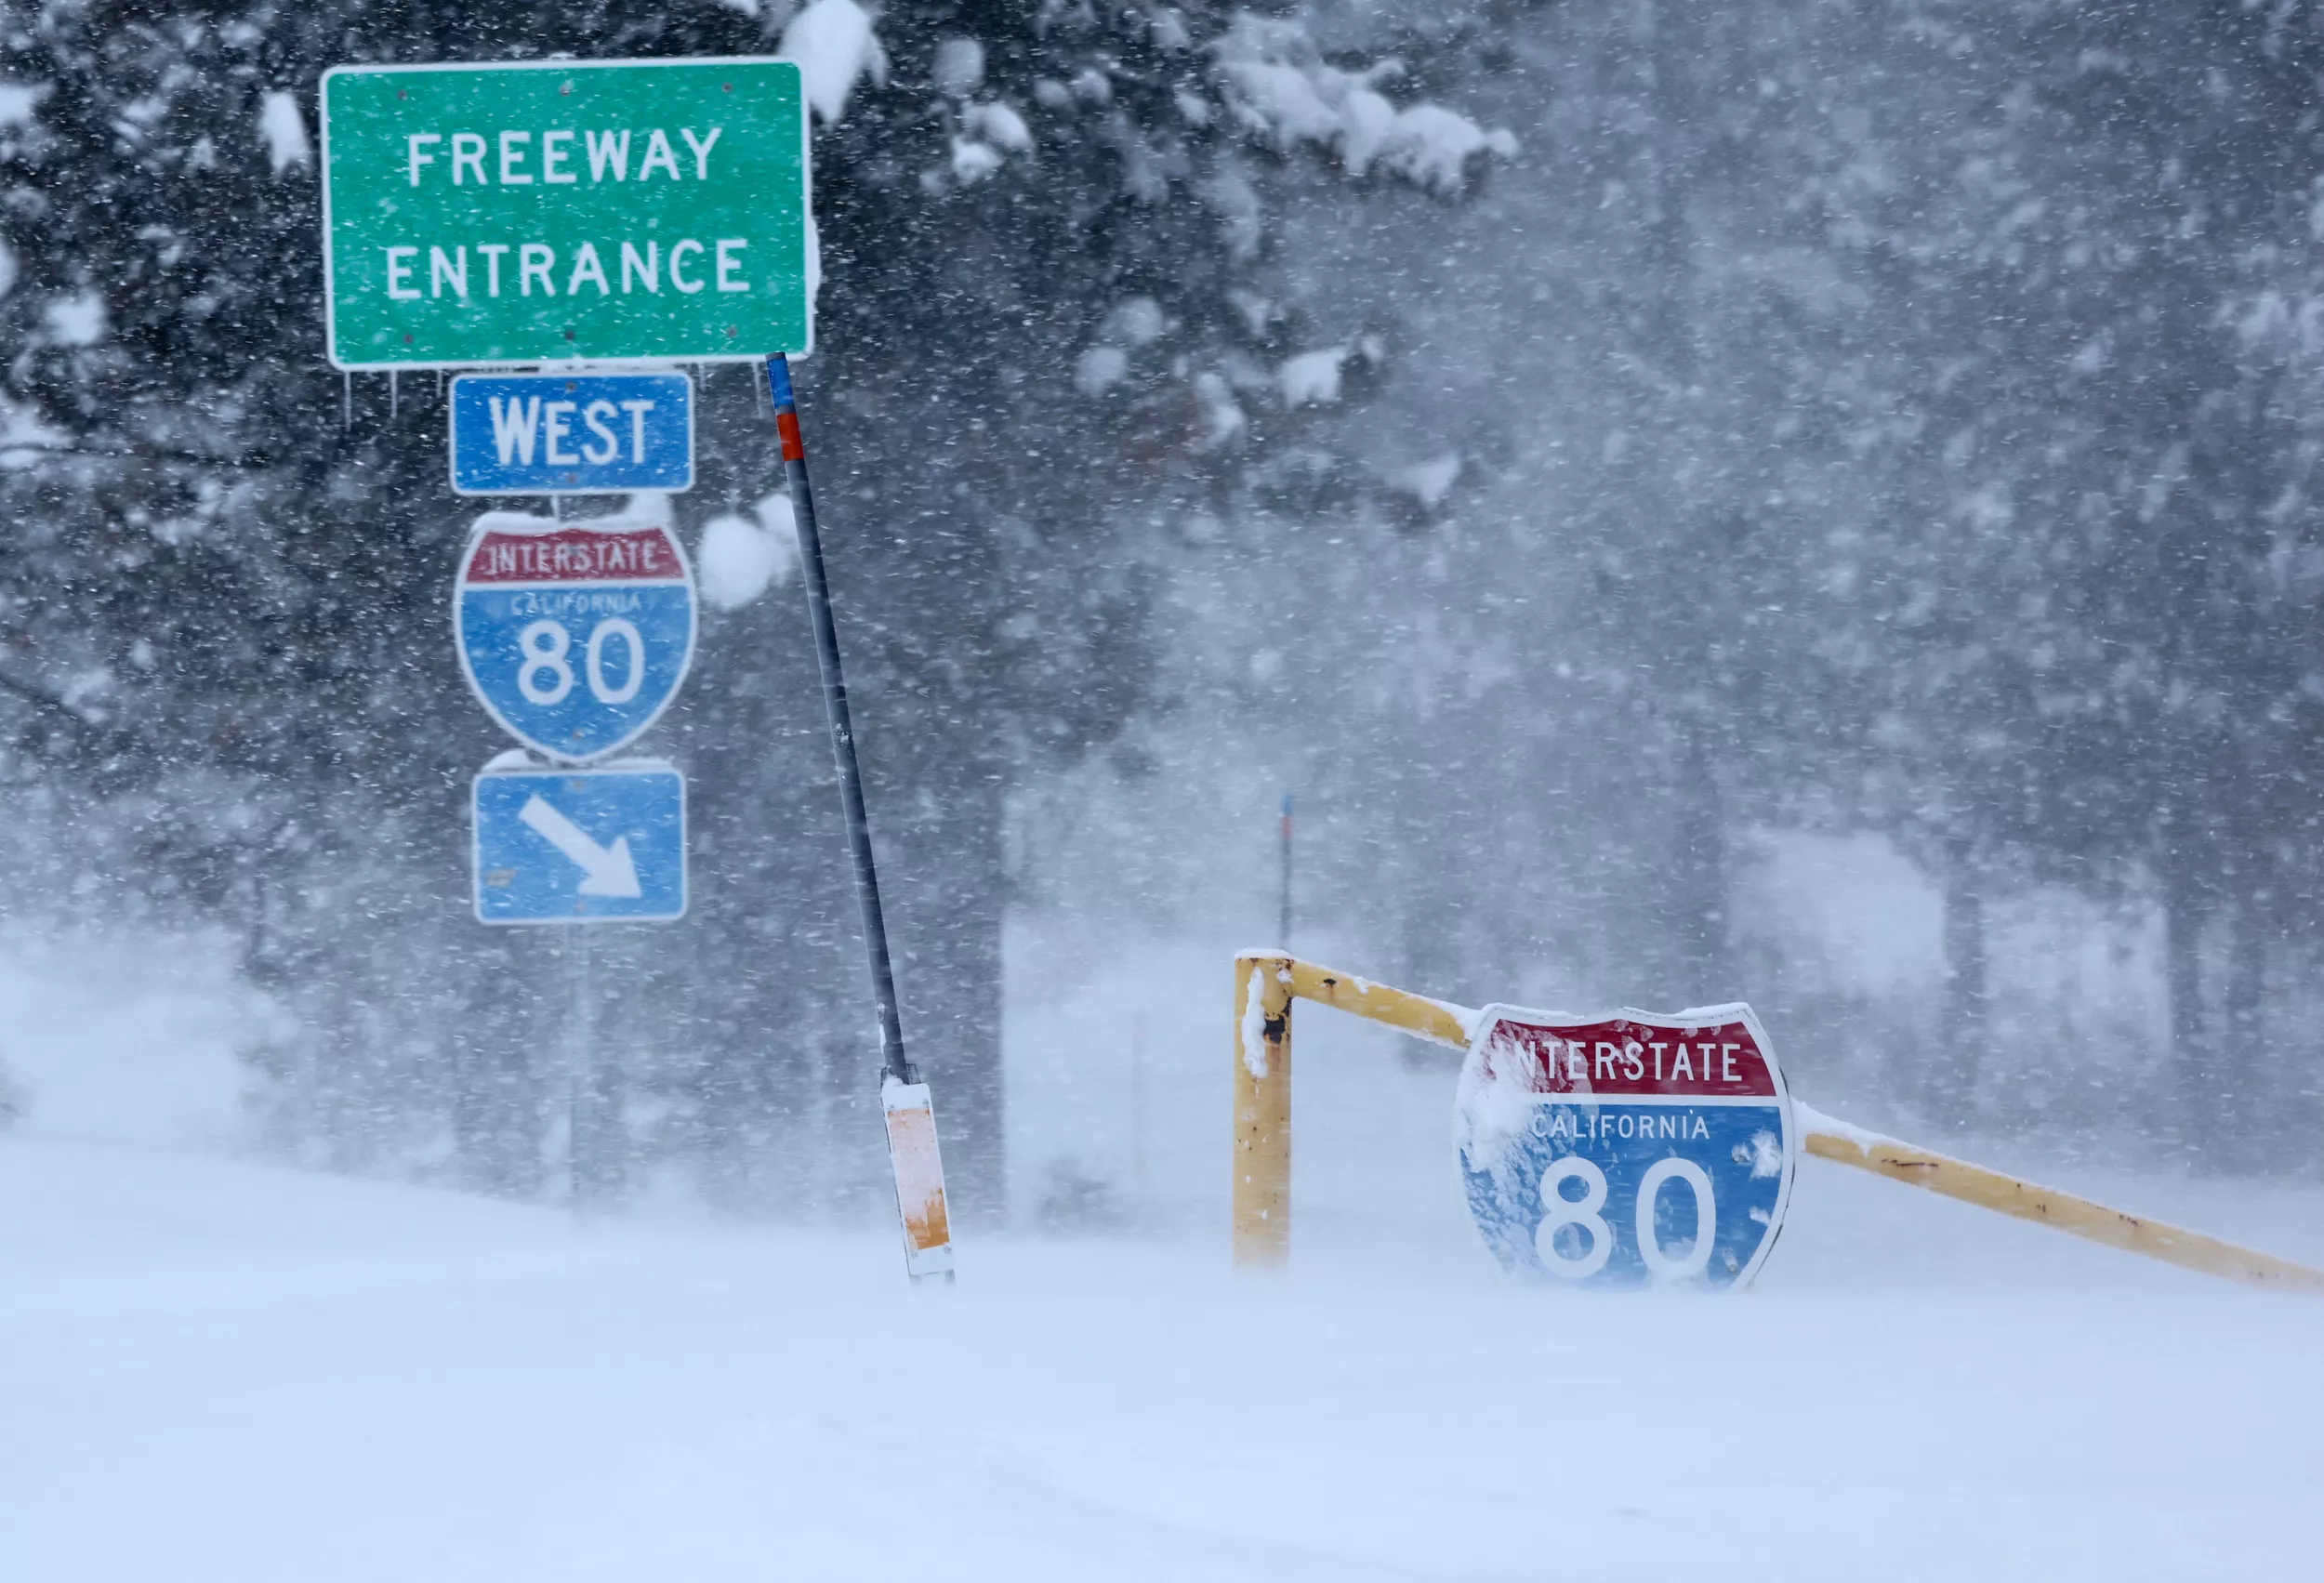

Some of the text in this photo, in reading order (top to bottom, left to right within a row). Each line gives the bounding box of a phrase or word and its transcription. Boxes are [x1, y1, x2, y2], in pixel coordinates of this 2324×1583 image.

[407, 126, 722, 187] FREEWAY
[386, 237, 751, 299] ENTRANCE
[487, 395, 654, 466] WEST
[486, 541, 658, 573] INTERSTATE
[512, 593, 642, 614] CALIFORNIA
[517, 619, 645, 706] 80
[1512, 1041, 1743, 1082] NTERSTATE
[1532, 1115, 1710, 1140] CALIFORNIA
[1535, 1155, 1717, 1279] 80
